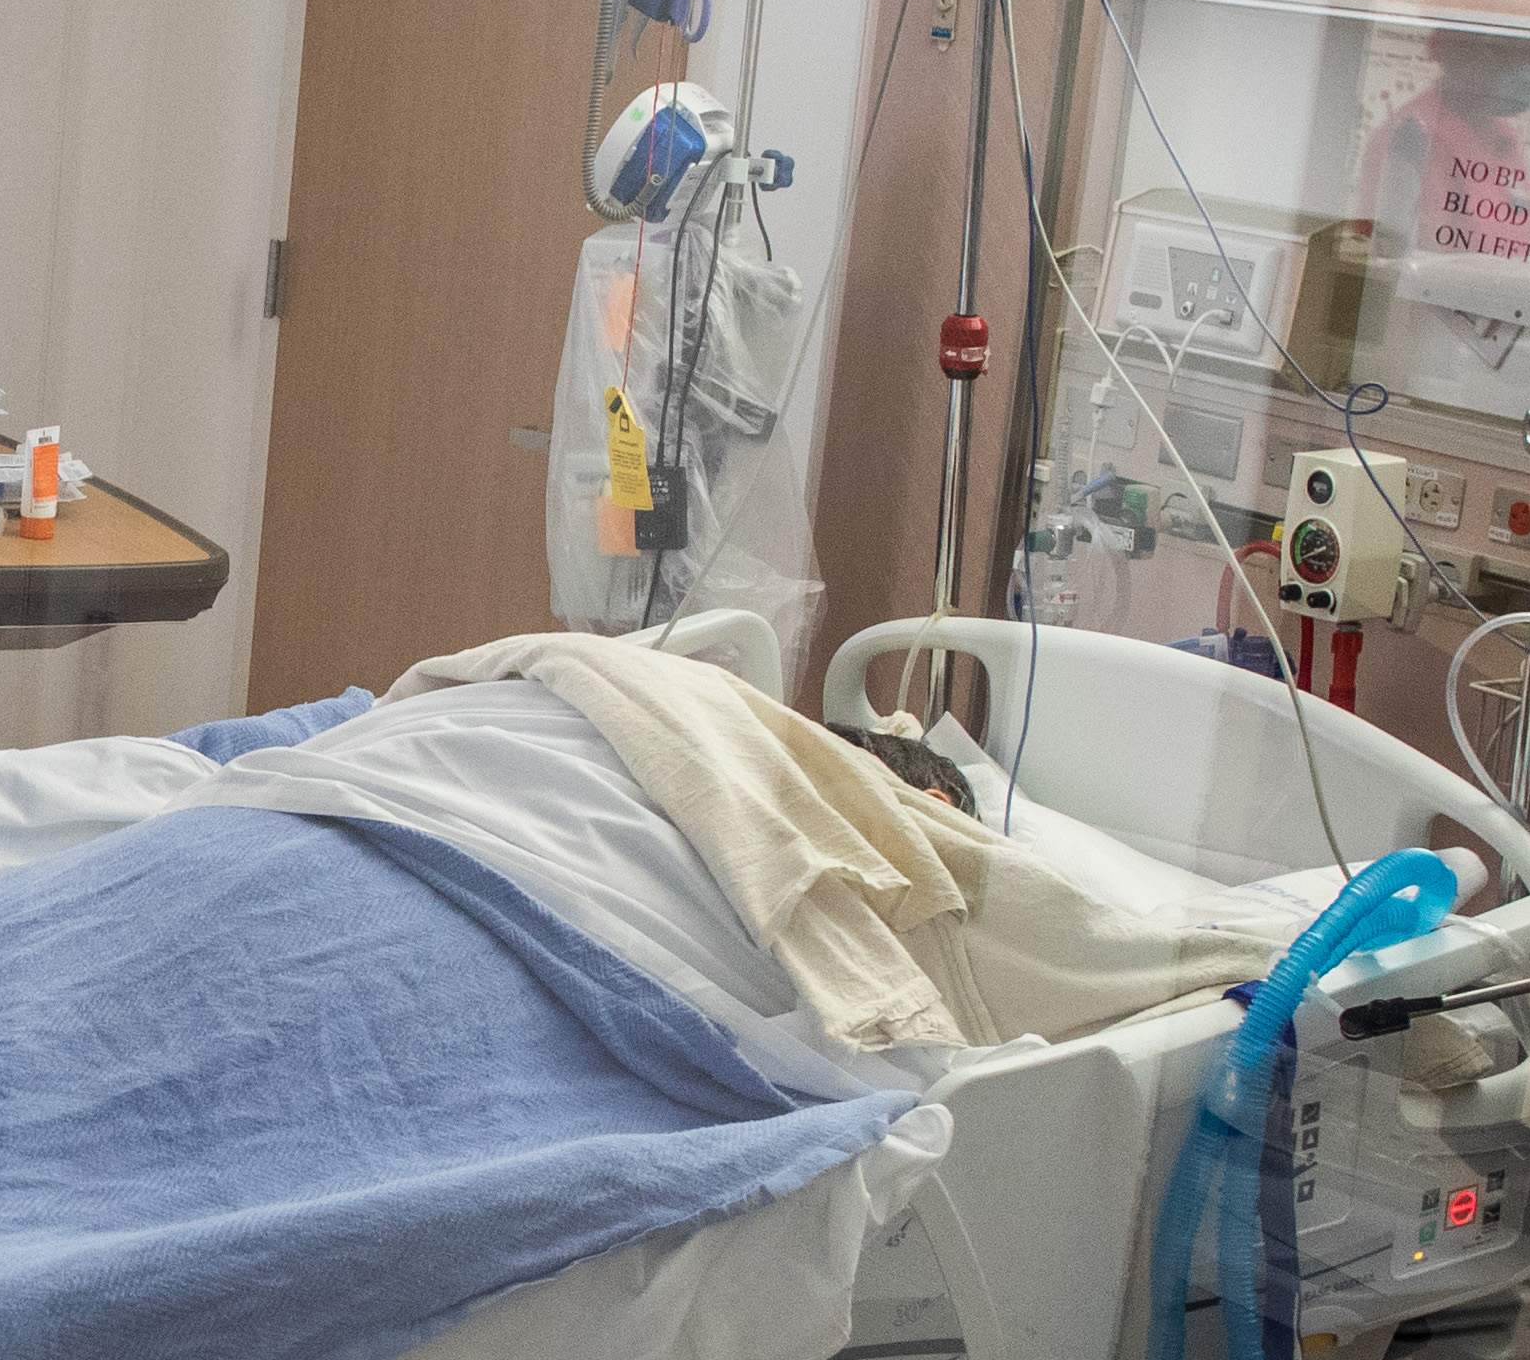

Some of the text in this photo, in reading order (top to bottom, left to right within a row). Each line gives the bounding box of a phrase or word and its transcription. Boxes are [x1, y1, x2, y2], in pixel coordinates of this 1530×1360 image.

[1450, 157, 1489, 183] NO
[1495, 165, 1525, 189] BP
[1443, 191, 1529, 226] BLOOD
[1435, 224, 1475, 250] ON
